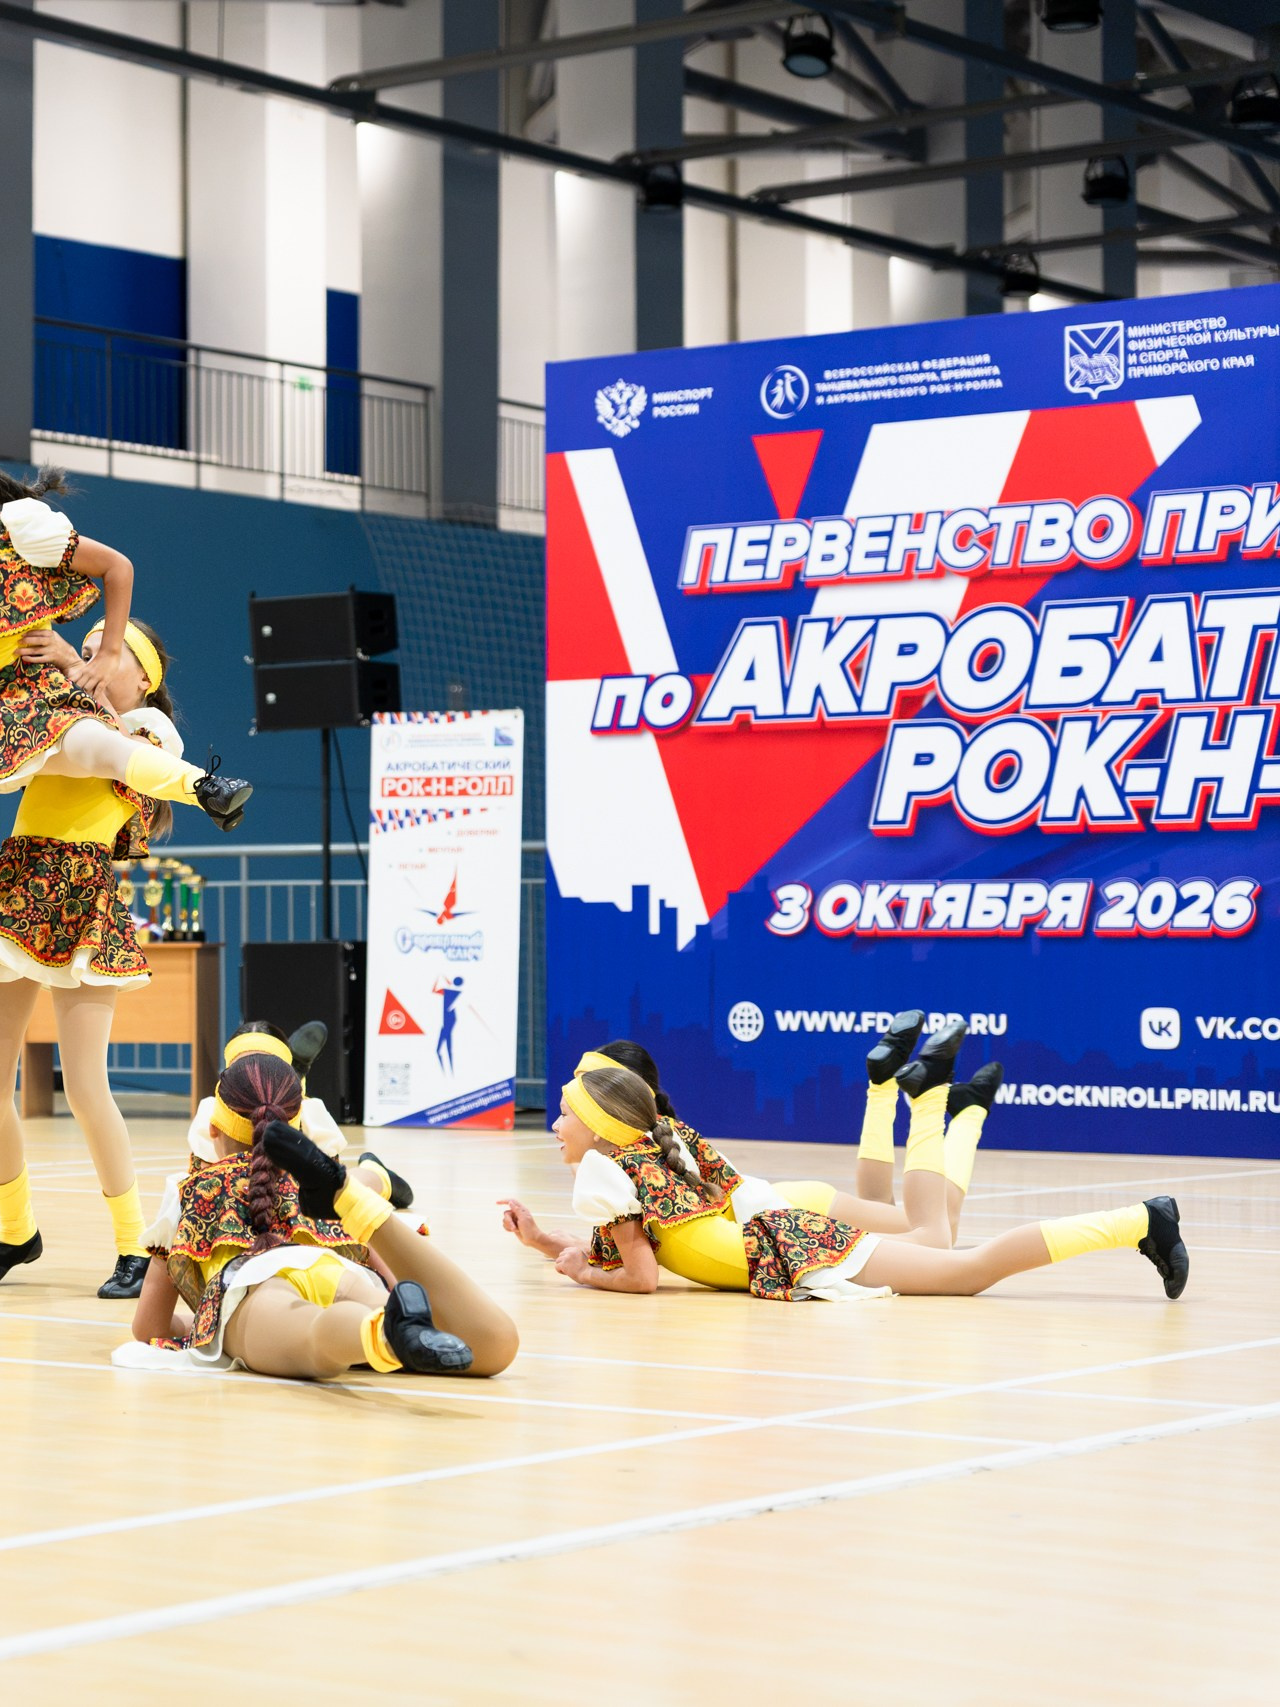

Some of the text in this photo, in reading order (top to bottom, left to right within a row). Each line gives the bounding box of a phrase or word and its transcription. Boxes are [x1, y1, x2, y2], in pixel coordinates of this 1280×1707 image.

[1127, 316, 1227, 338] МИНИСТЕРСТВО
[1127, 324, 1280, 351] ФИЗИЧЕСКОЙ КУЛЬТУРЫ
[823, 353, 991, 380] ВСЕРОССИЙСКАЯ ФЕДЕРАЦИЯ
[1127, 348, 1189, 365] И СПОРТА
[1127, 354, 1255, 379] ПРИМОРСКОГО КРАЯ
[815, 375, 897, 393] ТАНЦЕВАЛЬНОГО
[940, 364, 1001, 381] БРЕЙКИНГА
[815, 377, 1004, 405] И АКРОБАТИЧЕСКОГО РОК-Н-РОЛЛА
[651, 387, 714, 404] МИНСПОРТ
[651, 403, 700, 418] РОССИИ
[680, 495, 1140, 593] ПЕРВЕНСТВО
[693, 587, 1280, 730] АКРОБАТ
[386, 759, 511, 771] АКРОБАТИЧЕСКИЙ
[384, 777, 512, 795] РОК-Н-РОЛЛ
[765, 877, 1261, 936] 3 ОКТЯБРЯ 2026
[774, 1009, 1008, 1036] WWW.FDR.RU
[1194, 1016, 1280, 1041] VK.CO
[993, 1083, 1280, 1114] W.ROCKNROLLPRIM.RU
